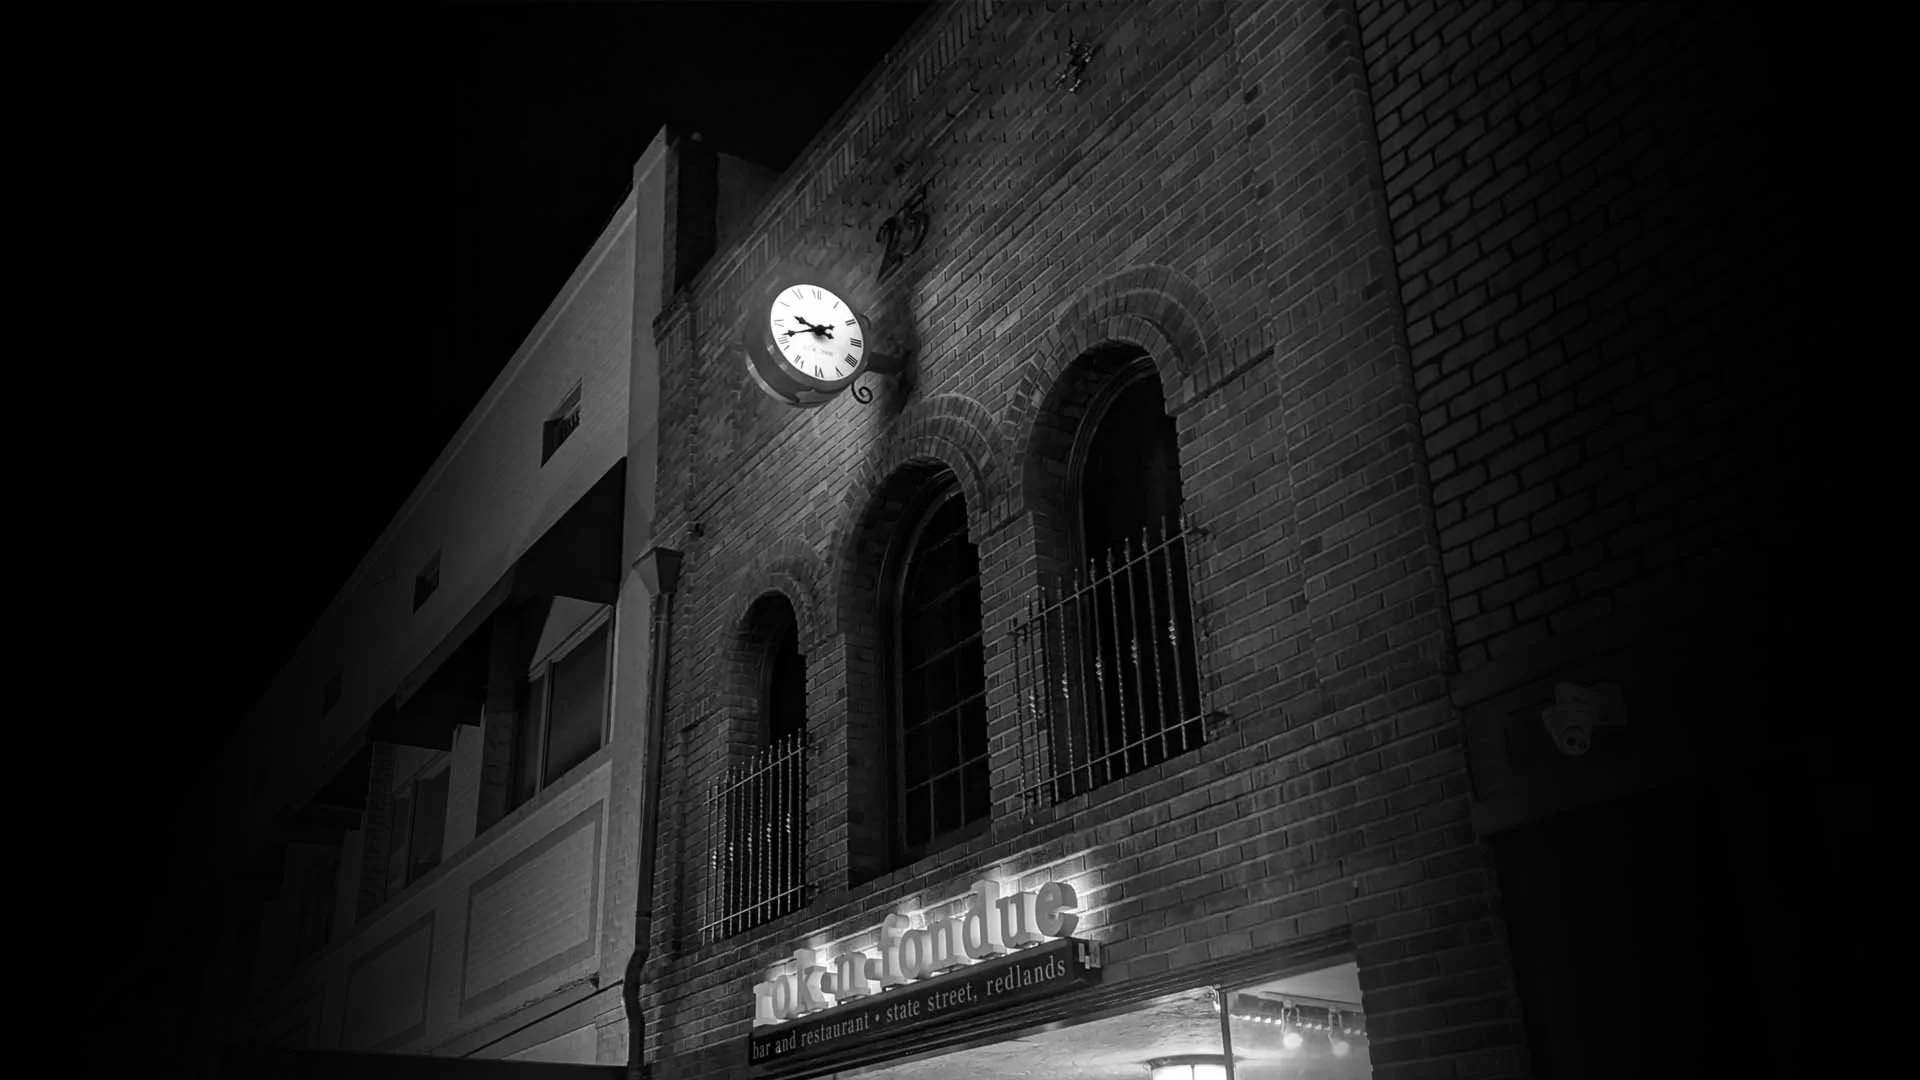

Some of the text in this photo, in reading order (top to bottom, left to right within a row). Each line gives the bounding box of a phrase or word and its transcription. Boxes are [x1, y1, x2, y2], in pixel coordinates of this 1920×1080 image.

[753, 955, 1066, 1060] bar and restaurant state street, redlands
